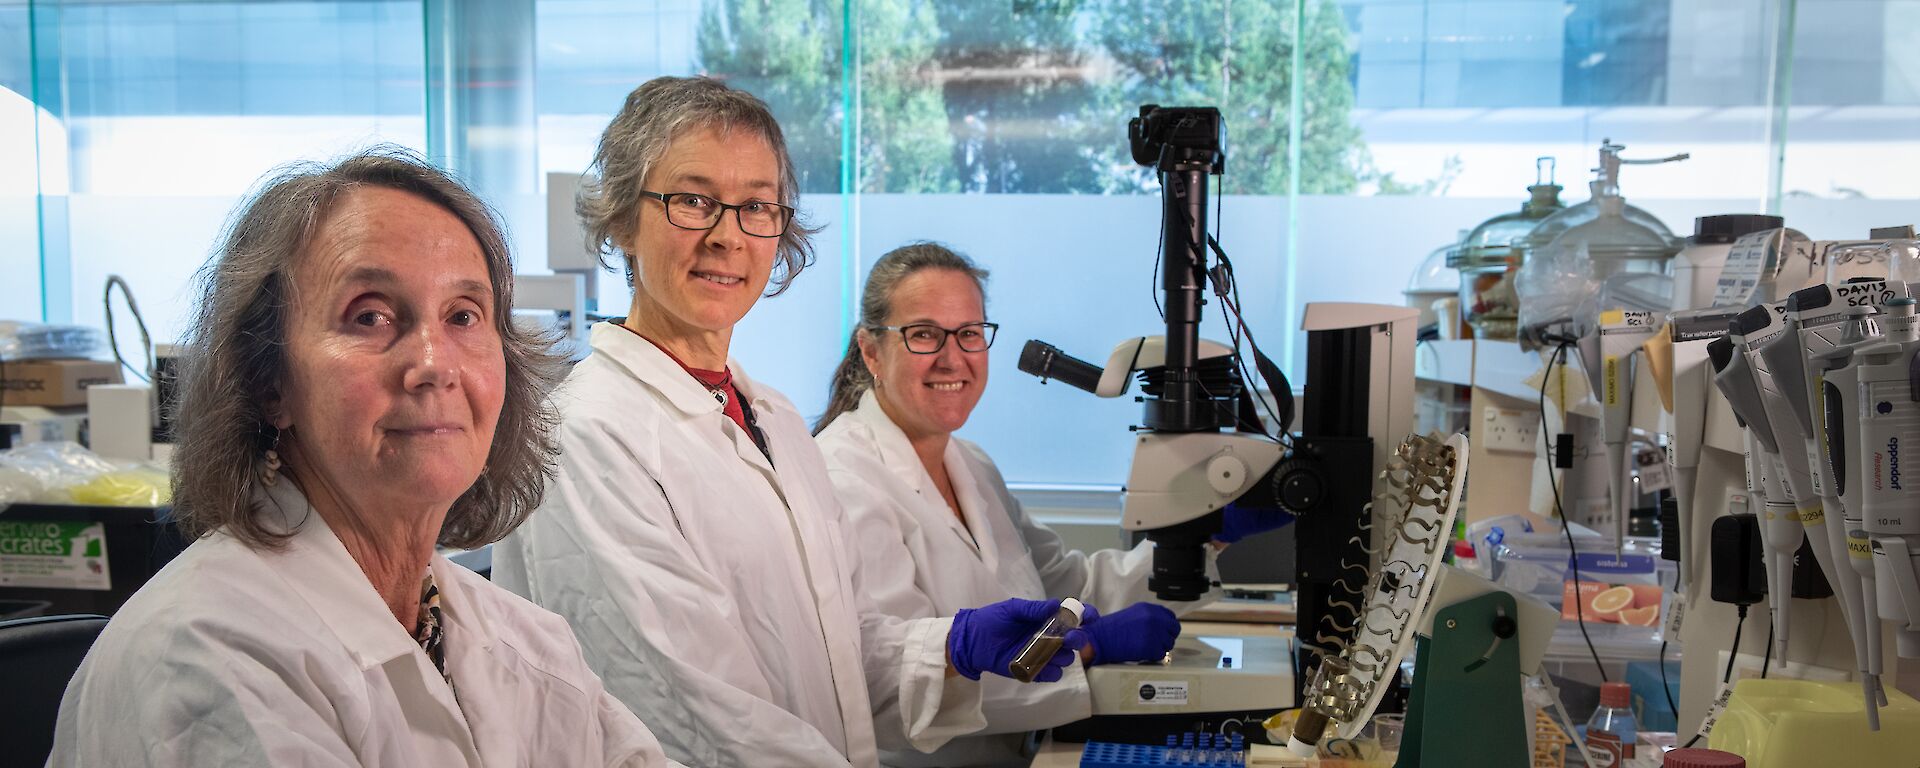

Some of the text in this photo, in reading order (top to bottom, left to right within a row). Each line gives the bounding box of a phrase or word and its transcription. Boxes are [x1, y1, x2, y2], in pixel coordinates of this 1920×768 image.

[1837, 282, 1887, 297] DAVIS
[1874, 452, 1882, 491] Research
[1888, 437, 1901, 490] eppendorf
[1879, 518, 1888, 526] 10
[1, 537, 64, 554] crates
[1848, 541, 1871, 553] MAXI
